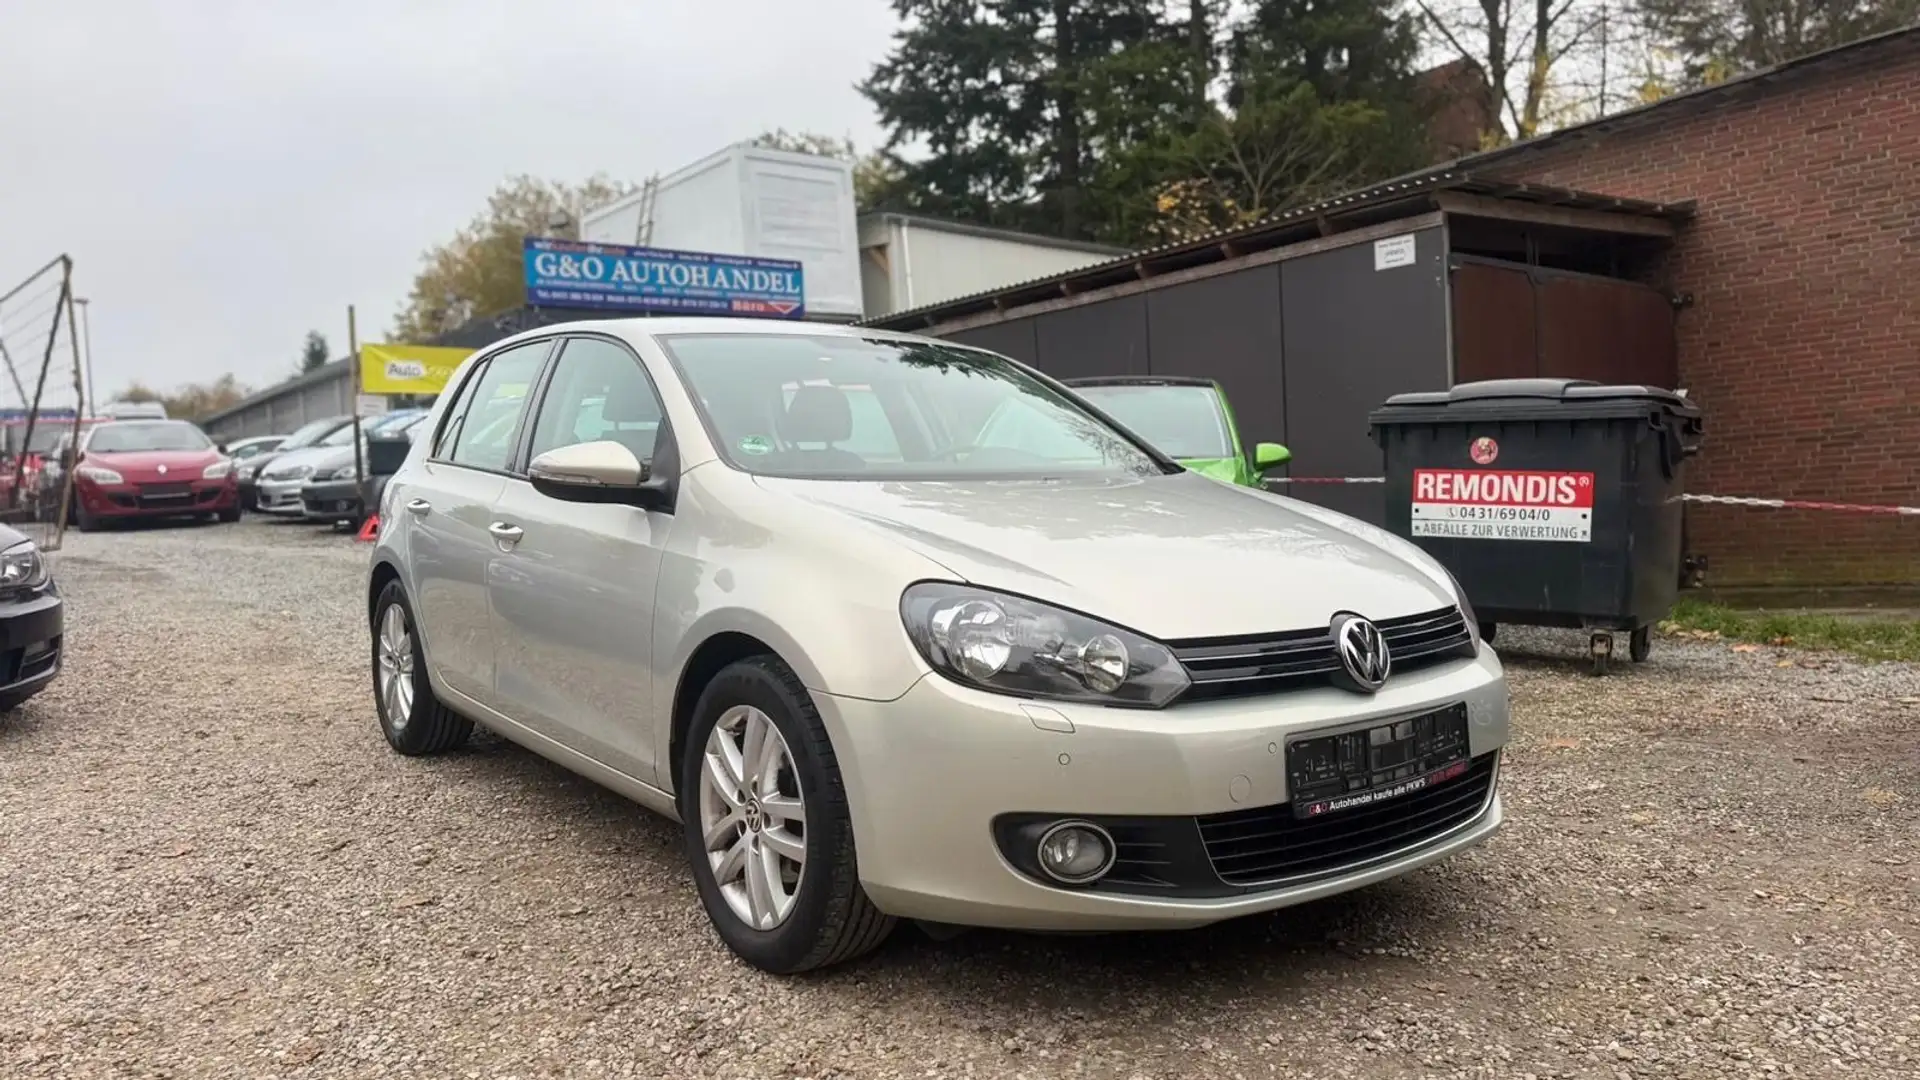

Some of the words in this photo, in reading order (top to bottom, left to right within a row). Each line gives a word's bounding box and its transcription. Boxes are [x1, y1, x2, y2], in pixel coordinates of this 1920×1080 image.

[535, 252, 604, 280] G&O
[610, 259, 800, 293] AUTOHANDEL
[1471, 524, 1493, 537] ZUR
[1496, 524, 1578, 539] VERWERTUNG
[1329, 793, 1372, 810] Autohandel
[1373, 788, 1393, 801] kaufe
